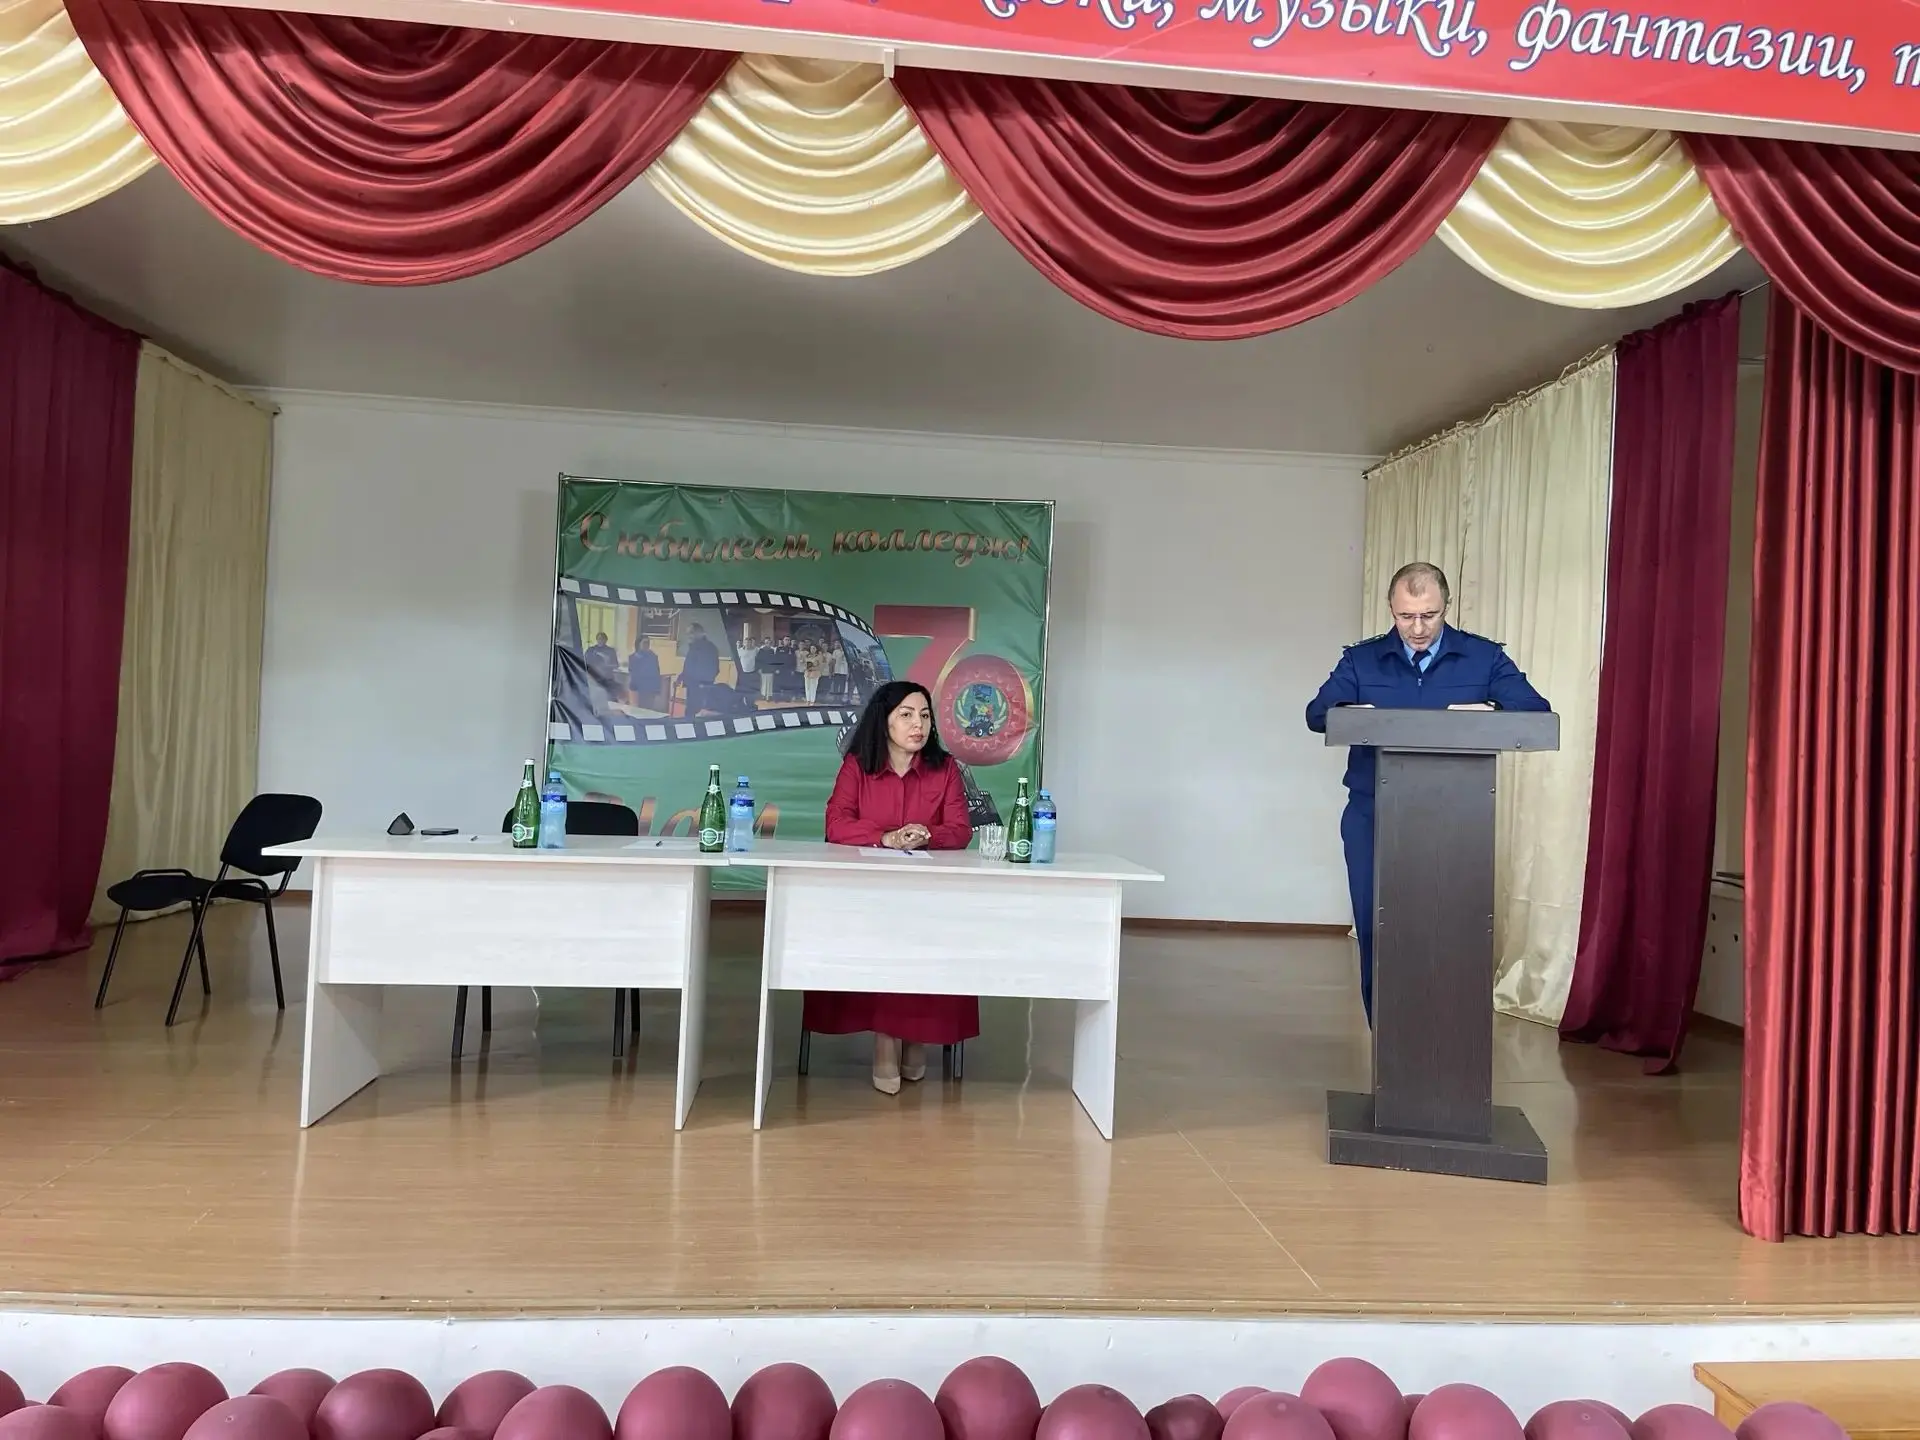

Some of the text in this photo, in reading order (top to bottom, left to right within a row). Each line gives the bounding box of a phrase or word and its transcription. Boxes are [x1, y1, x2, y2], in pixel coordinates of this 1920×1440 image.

[1508, 0, 1867, 94] фантазии,
[580, 511, 1032, 568] С юбилеем, колледж!
